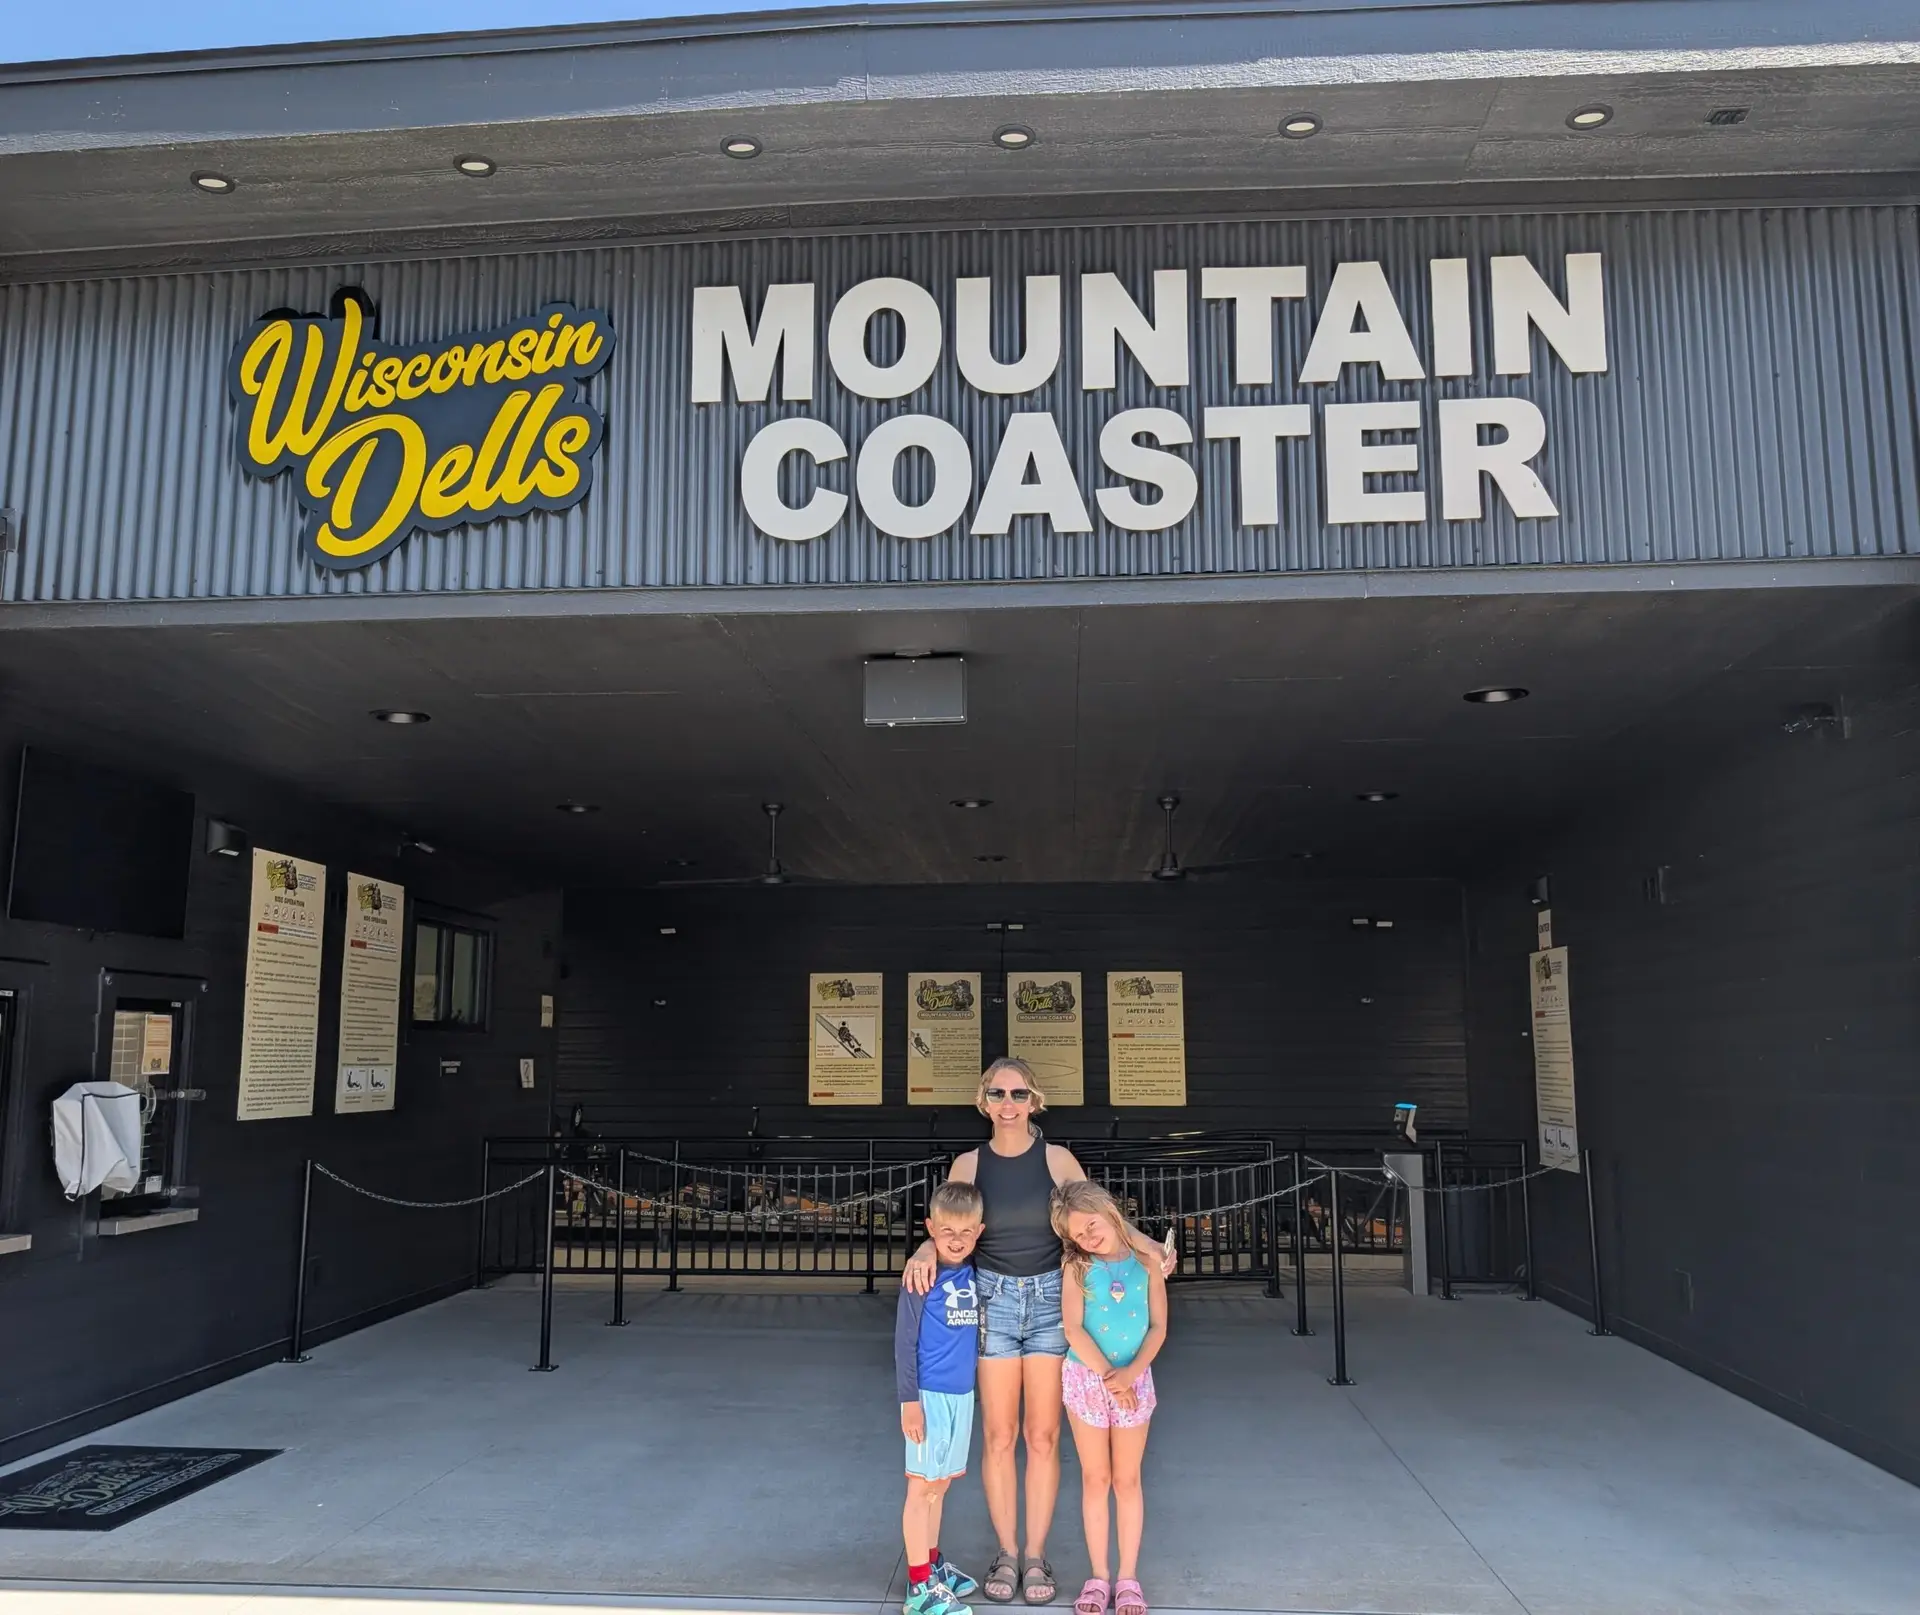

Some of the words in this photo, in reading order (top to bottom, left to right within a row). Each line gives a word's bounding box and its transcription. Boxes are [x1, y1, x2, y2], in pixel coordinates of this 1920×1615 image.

[691, 252, 1609, 402] MOUNTAIN
[240, 298, 603, 465] Wisconsin
[305, 383, 591, 557] Dells
[740, 397, 1560, 541] COASTER
[928, 997, 953, 1011] Dells
[1029, 997, 1053, 1013] Dells
[947, 1309, 978, 1318] UNDER
[947, 1318, 978, 1326] ARMOUR
